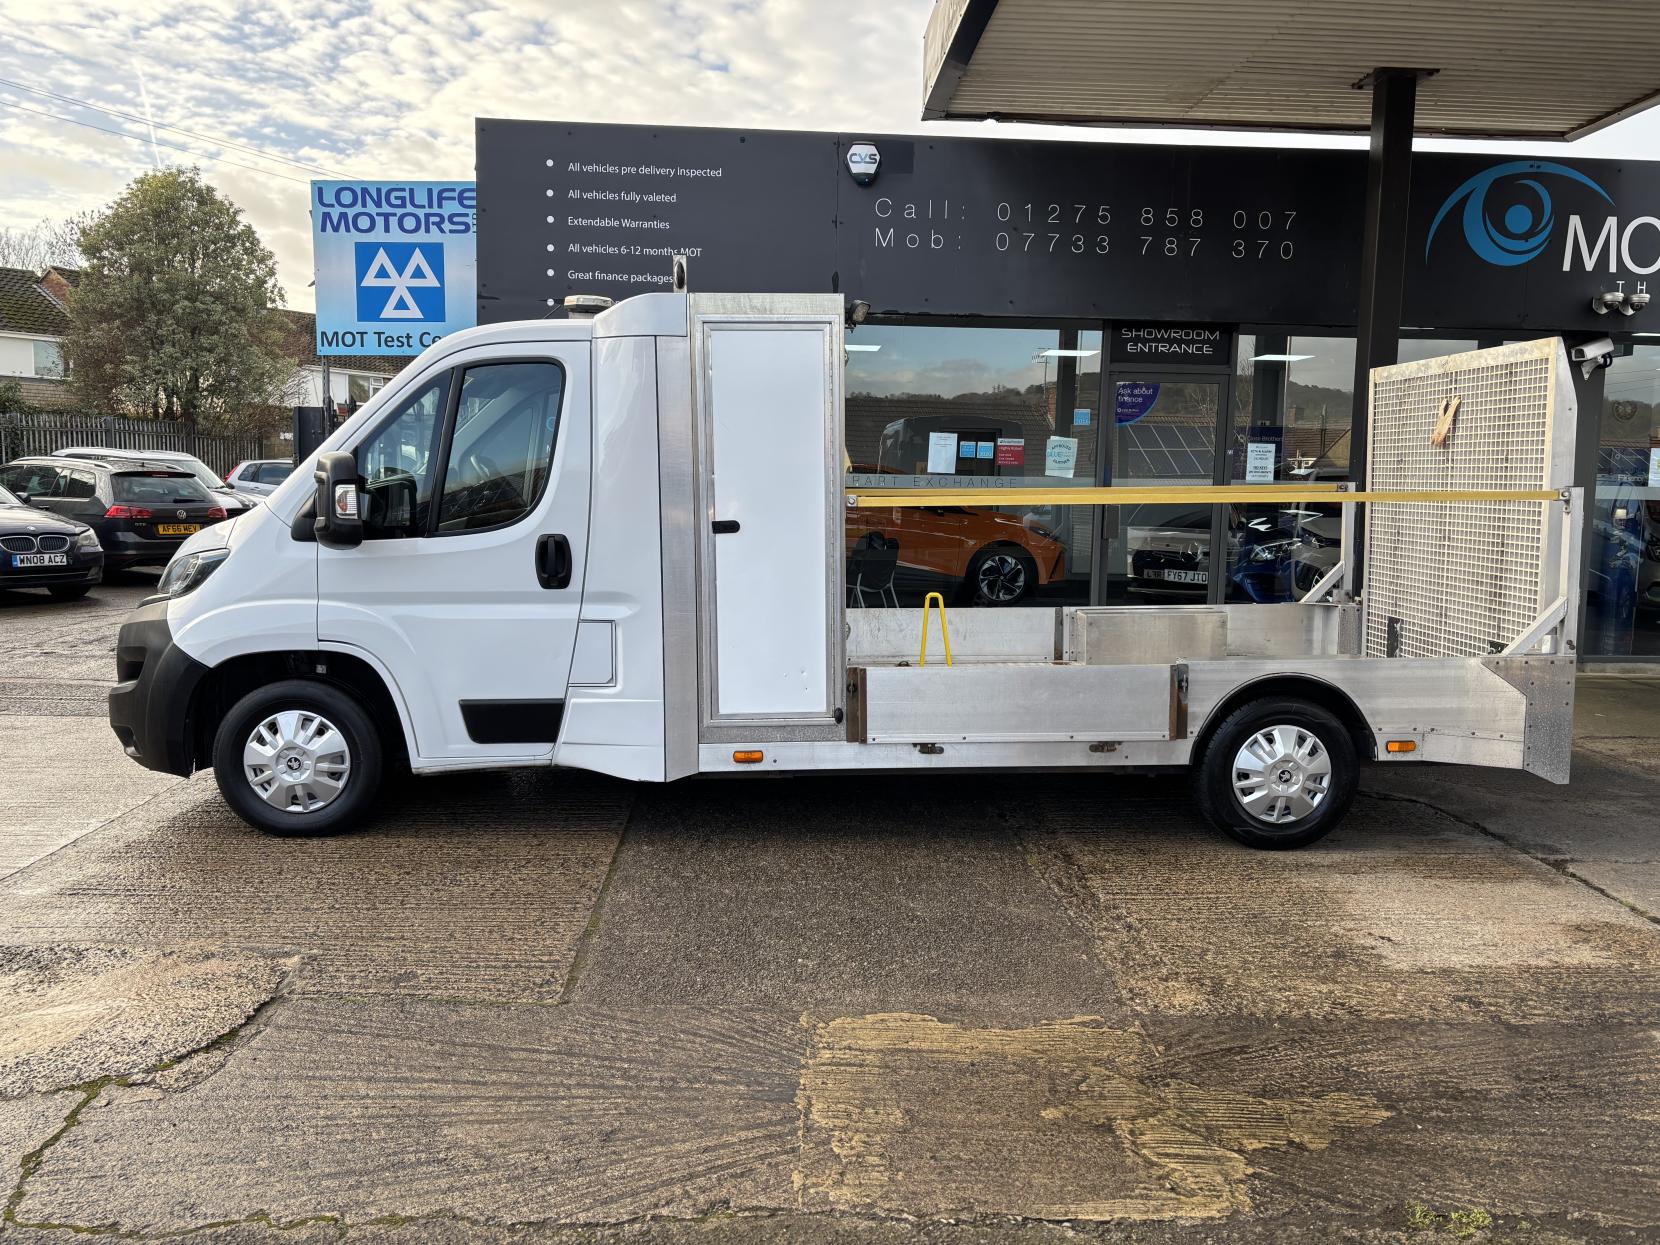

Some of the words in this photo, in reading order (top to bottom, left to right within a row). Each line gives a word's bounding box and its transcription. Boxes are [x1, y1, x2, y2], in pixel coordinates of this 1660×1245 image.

[849, 153, 878, 165] CVS
[568, 162, 580, 172] All
[582, 164, 619, 174] vehicles
[621, 166, 637, 176] pre
[638, 165, 676, 178] delivery
[677, 167, 722, 178] inspected
[317, 186, 477, 209] LONGLIFE
[568, 189, 580, 199] All
[582, 190, 619, 201] vehicles
[621, 192, 640, 203] fully
[643, 193, 677, 203] valeted
[875, 197, 965, 219] Call:
[997, 202, 1110, 225] 01275
[1140, 207, 1203, 228] 858
[1233, 210, 1297, 230] 007
[320, 211, 471, 235] MOTORS
[568, 216, 619, 228] Extendable
[621, 218, 670, 230] Warranties
[568, 243, 580, 253] All
[582, 244, 618, 255] vehicles
[620, 246, 641, 255] 6-12
[643, 247, 678, 256] months
[680, 247, 703, 257] MOT
[875, 227, 961, 250] Mob:
[996, 232, 1109, 254] 07733
[1140, 236, 1201, 257] 787
[1232, 239, 1294, 260] 370
[1562, 214, 1660, 275] MO
[568, 270, 593, 280] Great
[595, 271, 629, 281] finance
[630, 272, 673, 285] packages
[320, 331, 368, 348] MOT
[373, 331, 413, 348] Test
[1121, 327, 1220, 341] SHOWROOM
[1127, 342, 1214, 354] ENTRANCE
[1118, 387, 1131, 395] Ask
[1132, 387, 1153, 395] about
[912, 476, 1018, 489] EXCHANGE
[18, 555, 45, 565] WN08
[47, 554, 66, 564] ACZ
[1167, 570, 1188, 580] FY67
